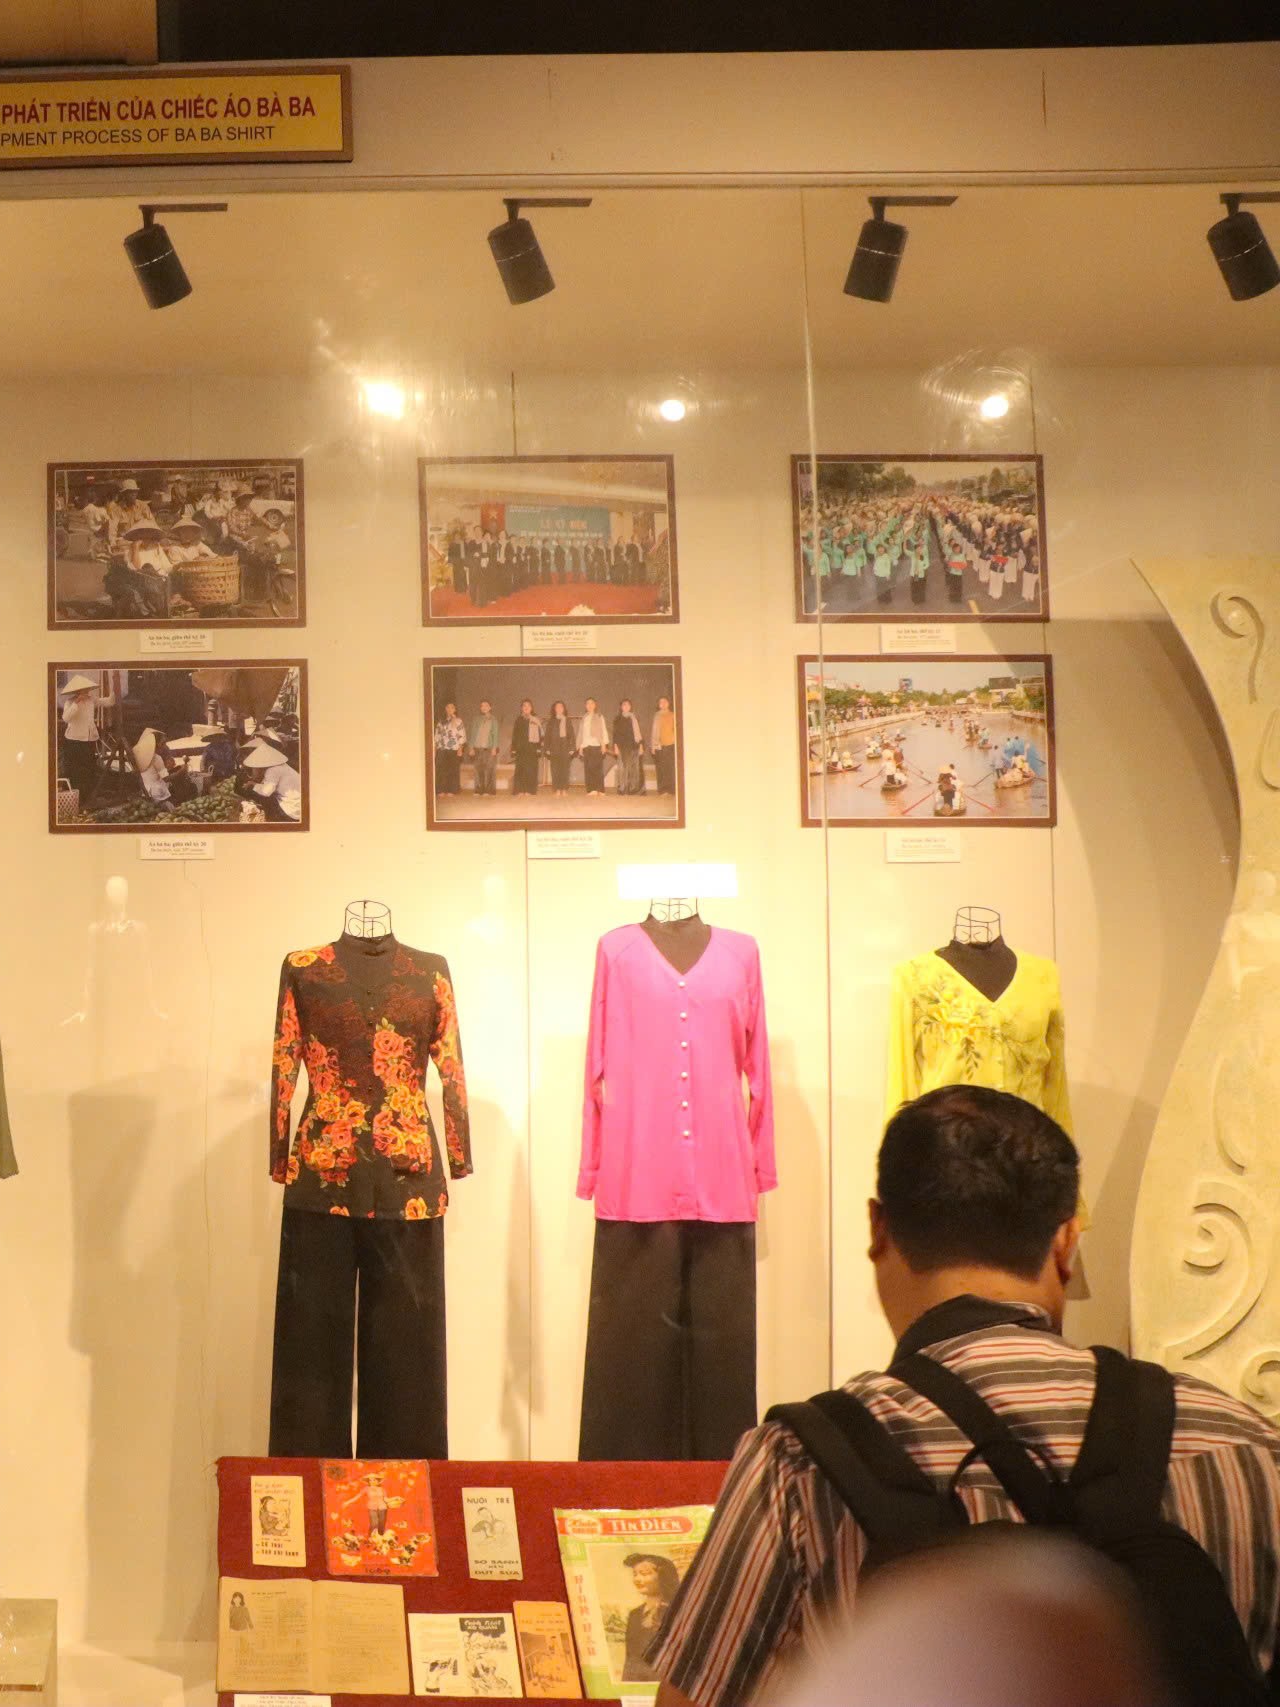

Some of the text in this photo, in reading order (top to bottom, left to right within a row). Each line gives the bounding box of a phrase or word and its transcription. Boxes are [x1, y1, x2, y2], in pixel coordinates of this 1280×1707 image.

[1, 97, 51, 125] PHÁT
[56, 97, 111, 123] TRIỂN
[116, 95, 157, 121] CỦA
[161, 94, 218, 120] CHIẾC
[223, 93, 252, 118] ÁO
[256, 91, 284, 118] BÀ
[288, 96, 316, 117] BA
[62, 128, 142, 147] PROCESS
[147, 128, 170, 143] OF
[174, 128, 197, 142] BA
[200, 127, 223, 141] BA
[226, 126, 276, 141] SHIRT
